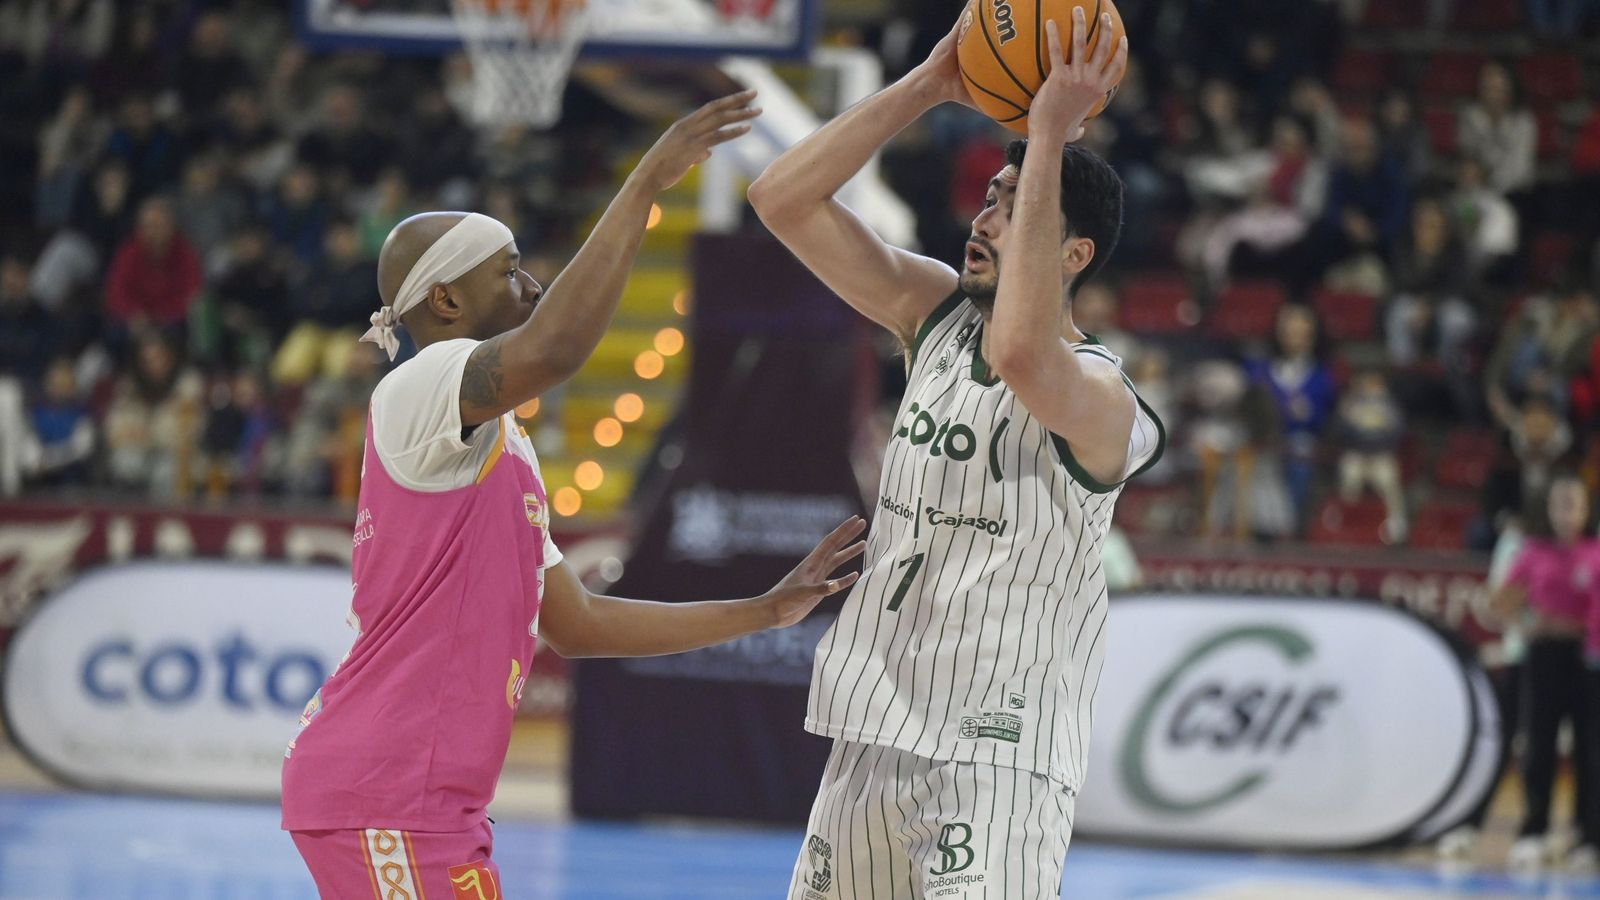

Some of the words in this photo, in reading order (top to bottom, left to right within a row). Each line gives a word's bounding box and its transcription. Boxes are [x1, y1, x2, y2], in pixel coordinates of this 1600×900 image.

[898, 402, 976, 461] coto
[926, 507, 1008, 537] Cajasol
[81, 633, 327, 711] coto
[1165, 681, 1342, 755] CSIF
[935, 887, 960, 897] HOTELS
